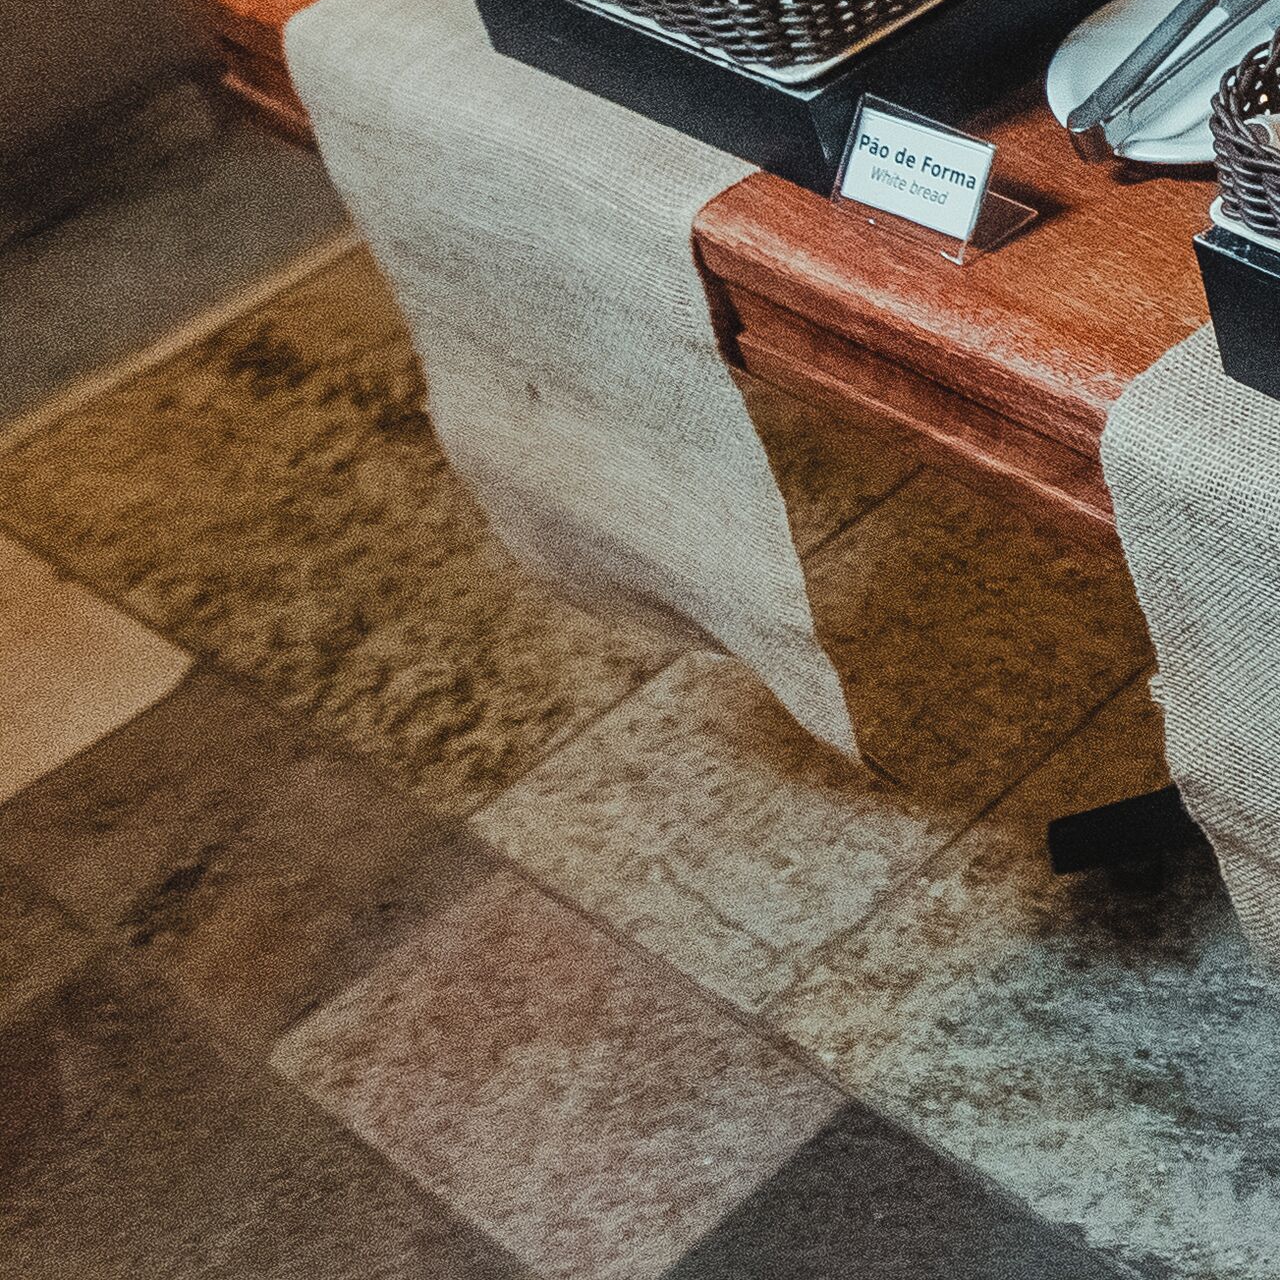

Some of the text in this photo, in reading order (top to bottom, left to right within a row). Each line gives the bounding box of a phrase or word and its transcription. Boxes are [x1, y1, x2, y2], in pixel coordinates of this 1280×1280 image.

[858, 134, 977, 190] Pão de Forma
[870, 166, 949, 205] White bread
